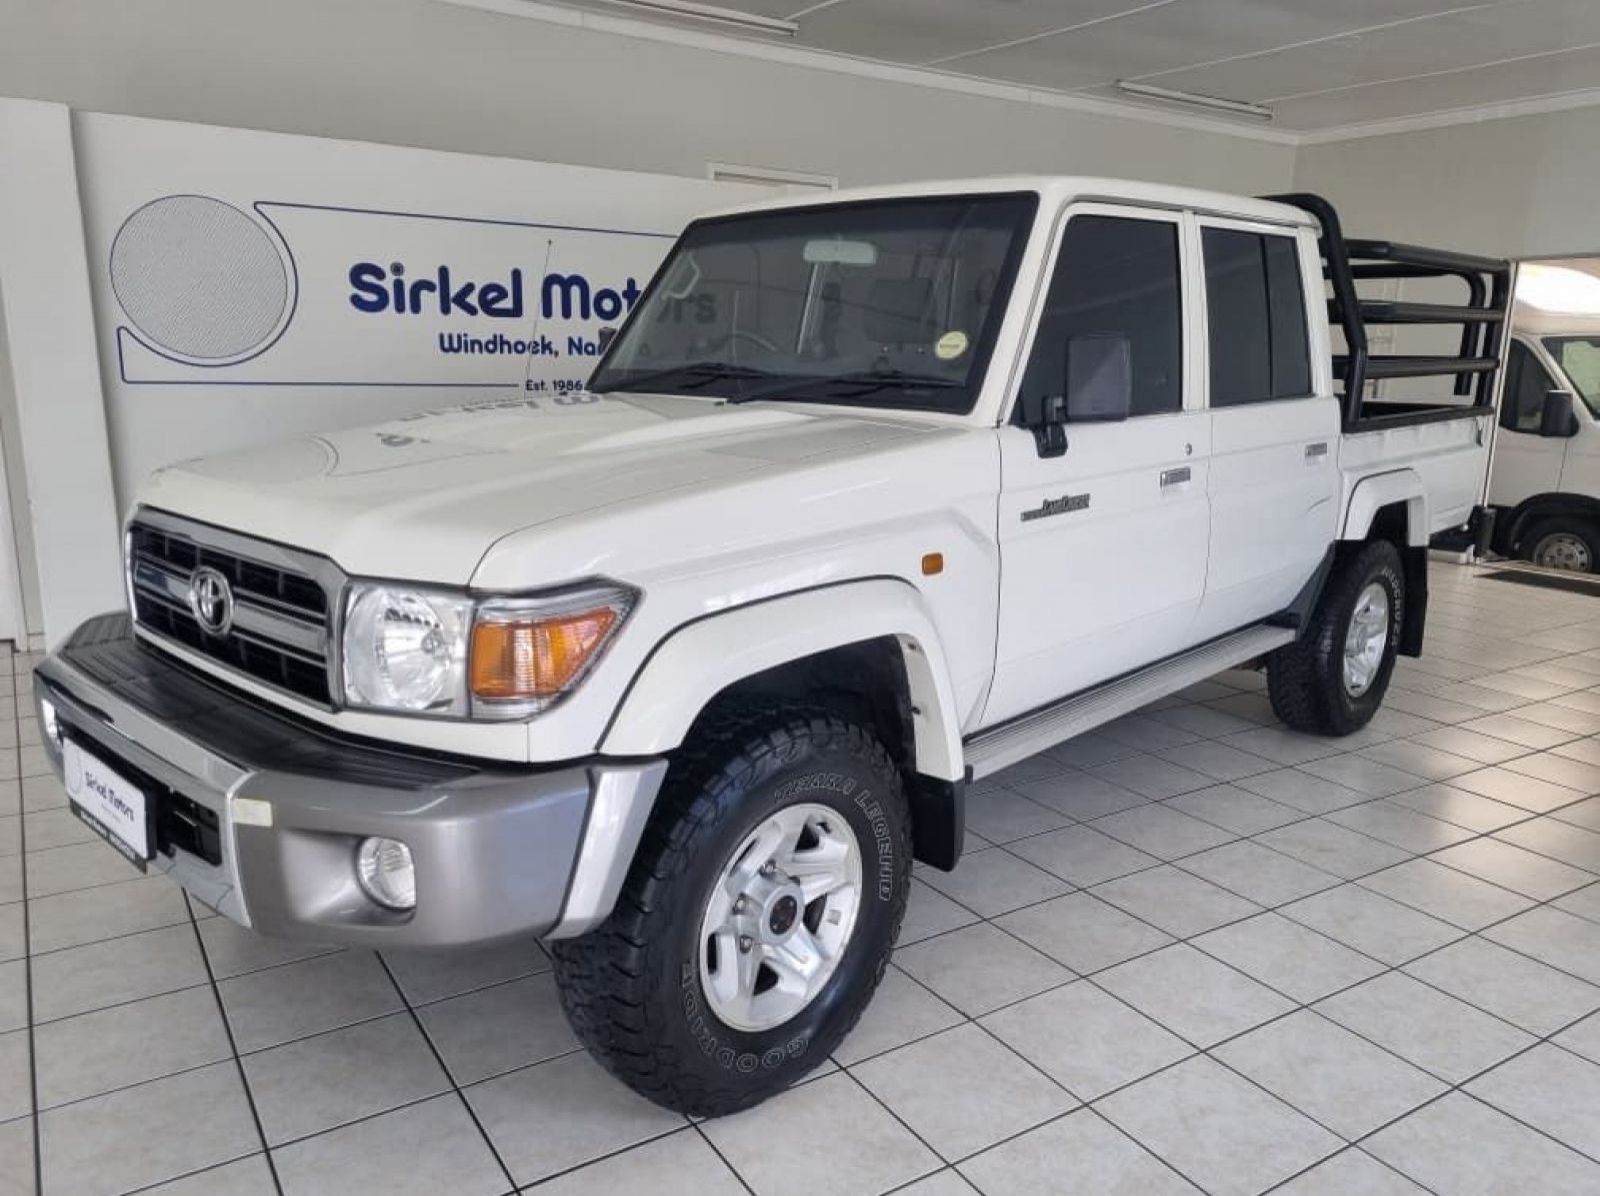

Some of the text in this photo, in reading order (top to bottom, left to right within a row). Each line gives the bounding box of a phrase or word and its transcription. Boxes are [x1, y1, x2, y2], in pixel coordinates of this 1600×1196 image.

[349, 263, 717, 323] Sirkel Motrs
[439, 333, 560, 358] Windhoek,
[526, 379, 583, 391] Est. 1986
